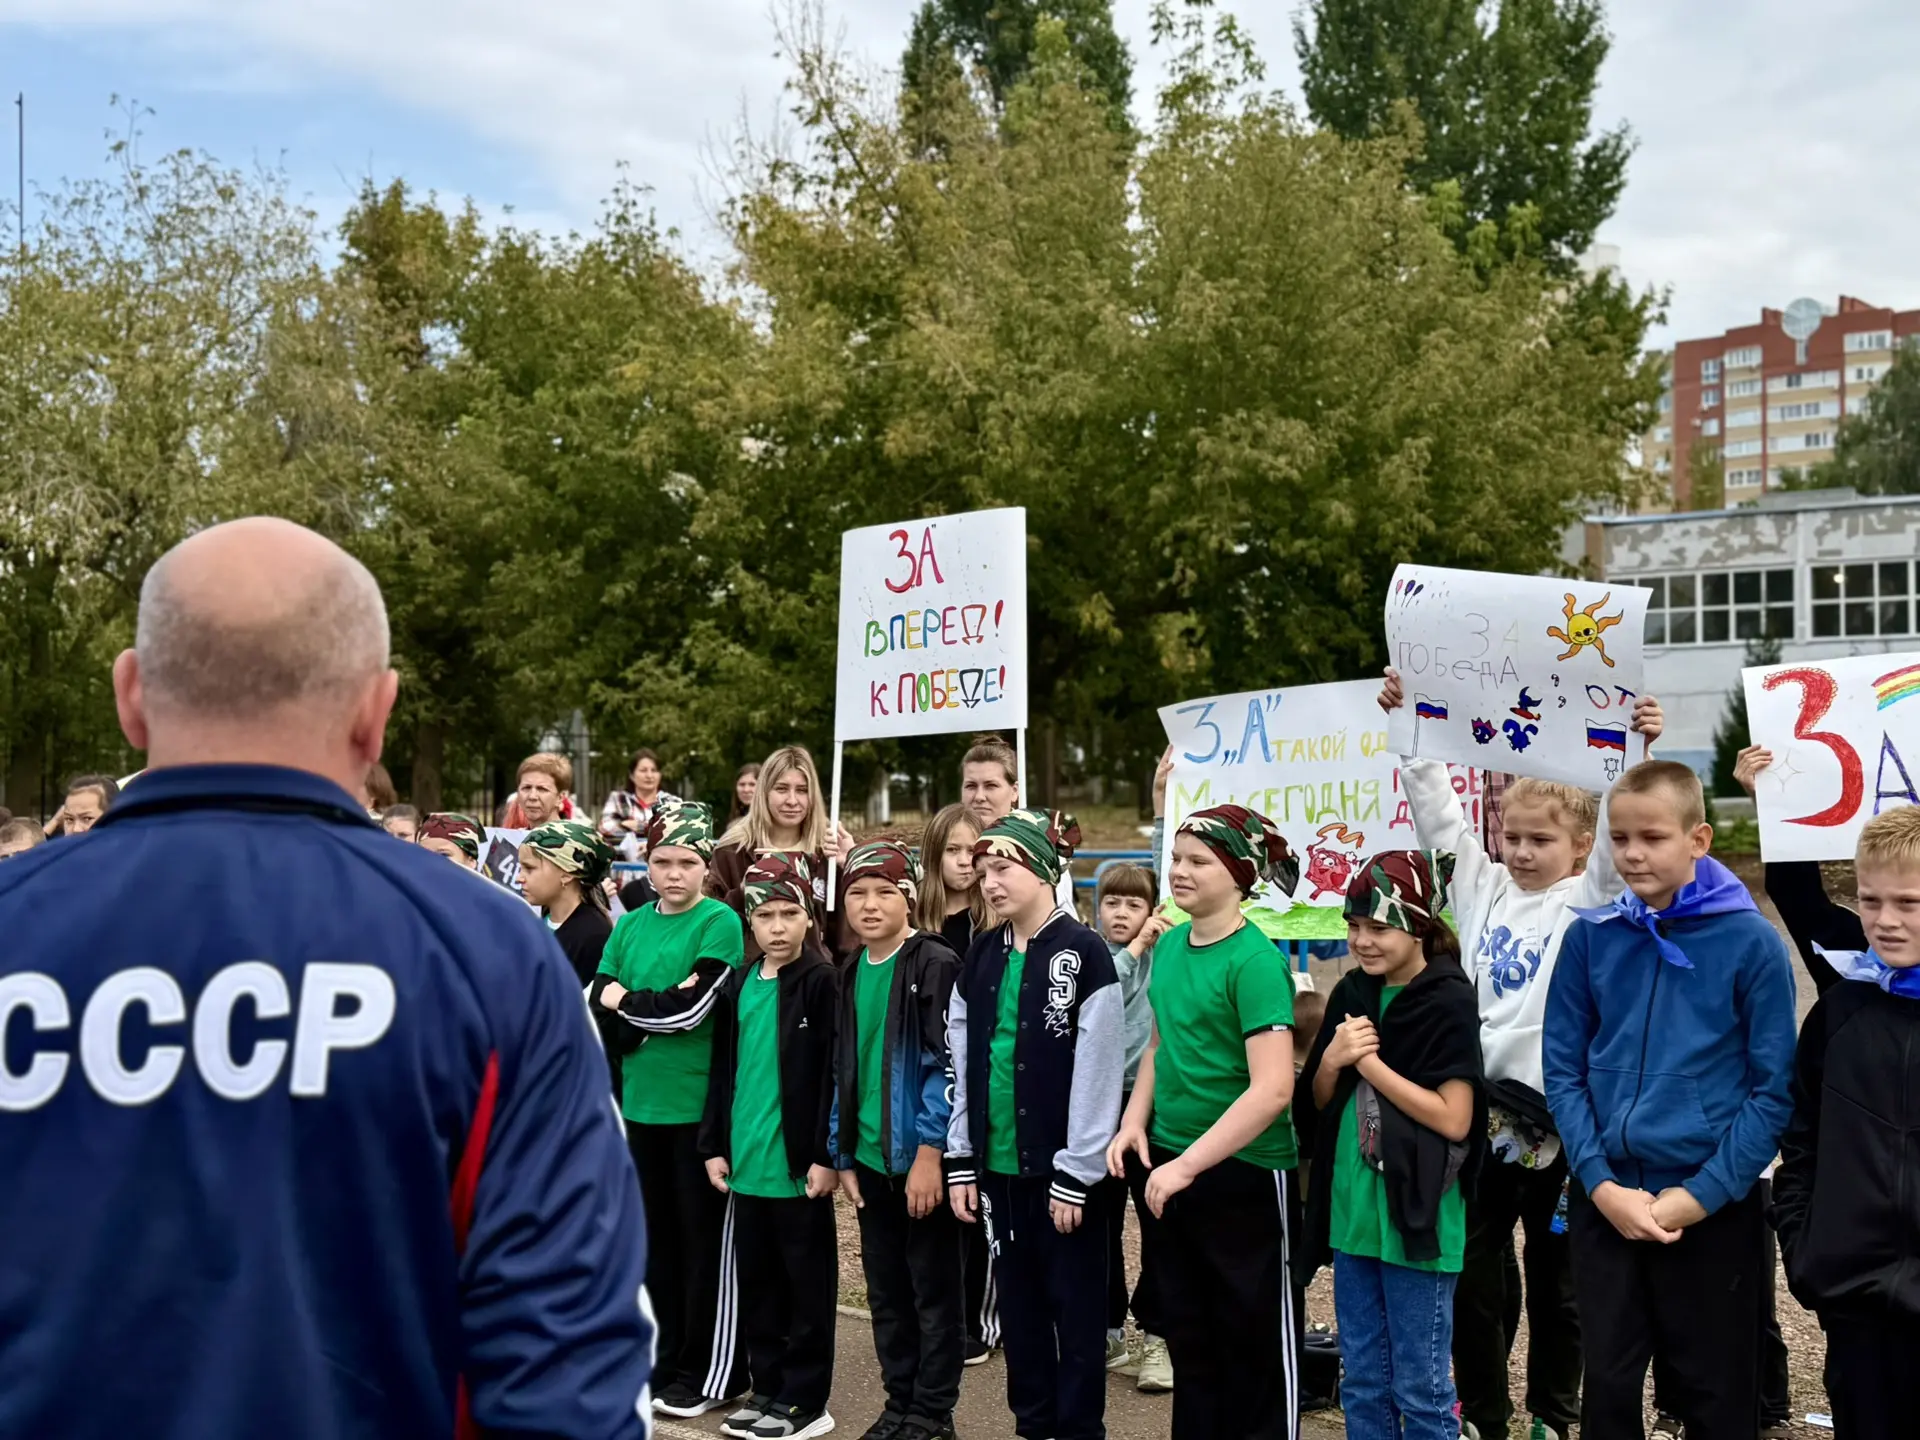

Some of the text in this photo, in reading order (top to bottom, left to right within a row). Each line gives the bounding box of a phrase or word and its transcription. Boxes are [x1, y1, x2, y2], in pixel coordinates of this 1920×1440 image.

[864, 600, 1004, 657] ВПЕРЕД!
[871, 665, 1006, 717] К ПОБЕДЕ!
[1585, 684, 1636, 709] ОТ
[1270, 726, 1348, 763] ТАКОЙ
[1048, 949, 1082, 1010] S
[0, 961, 397, 1112] СССР
